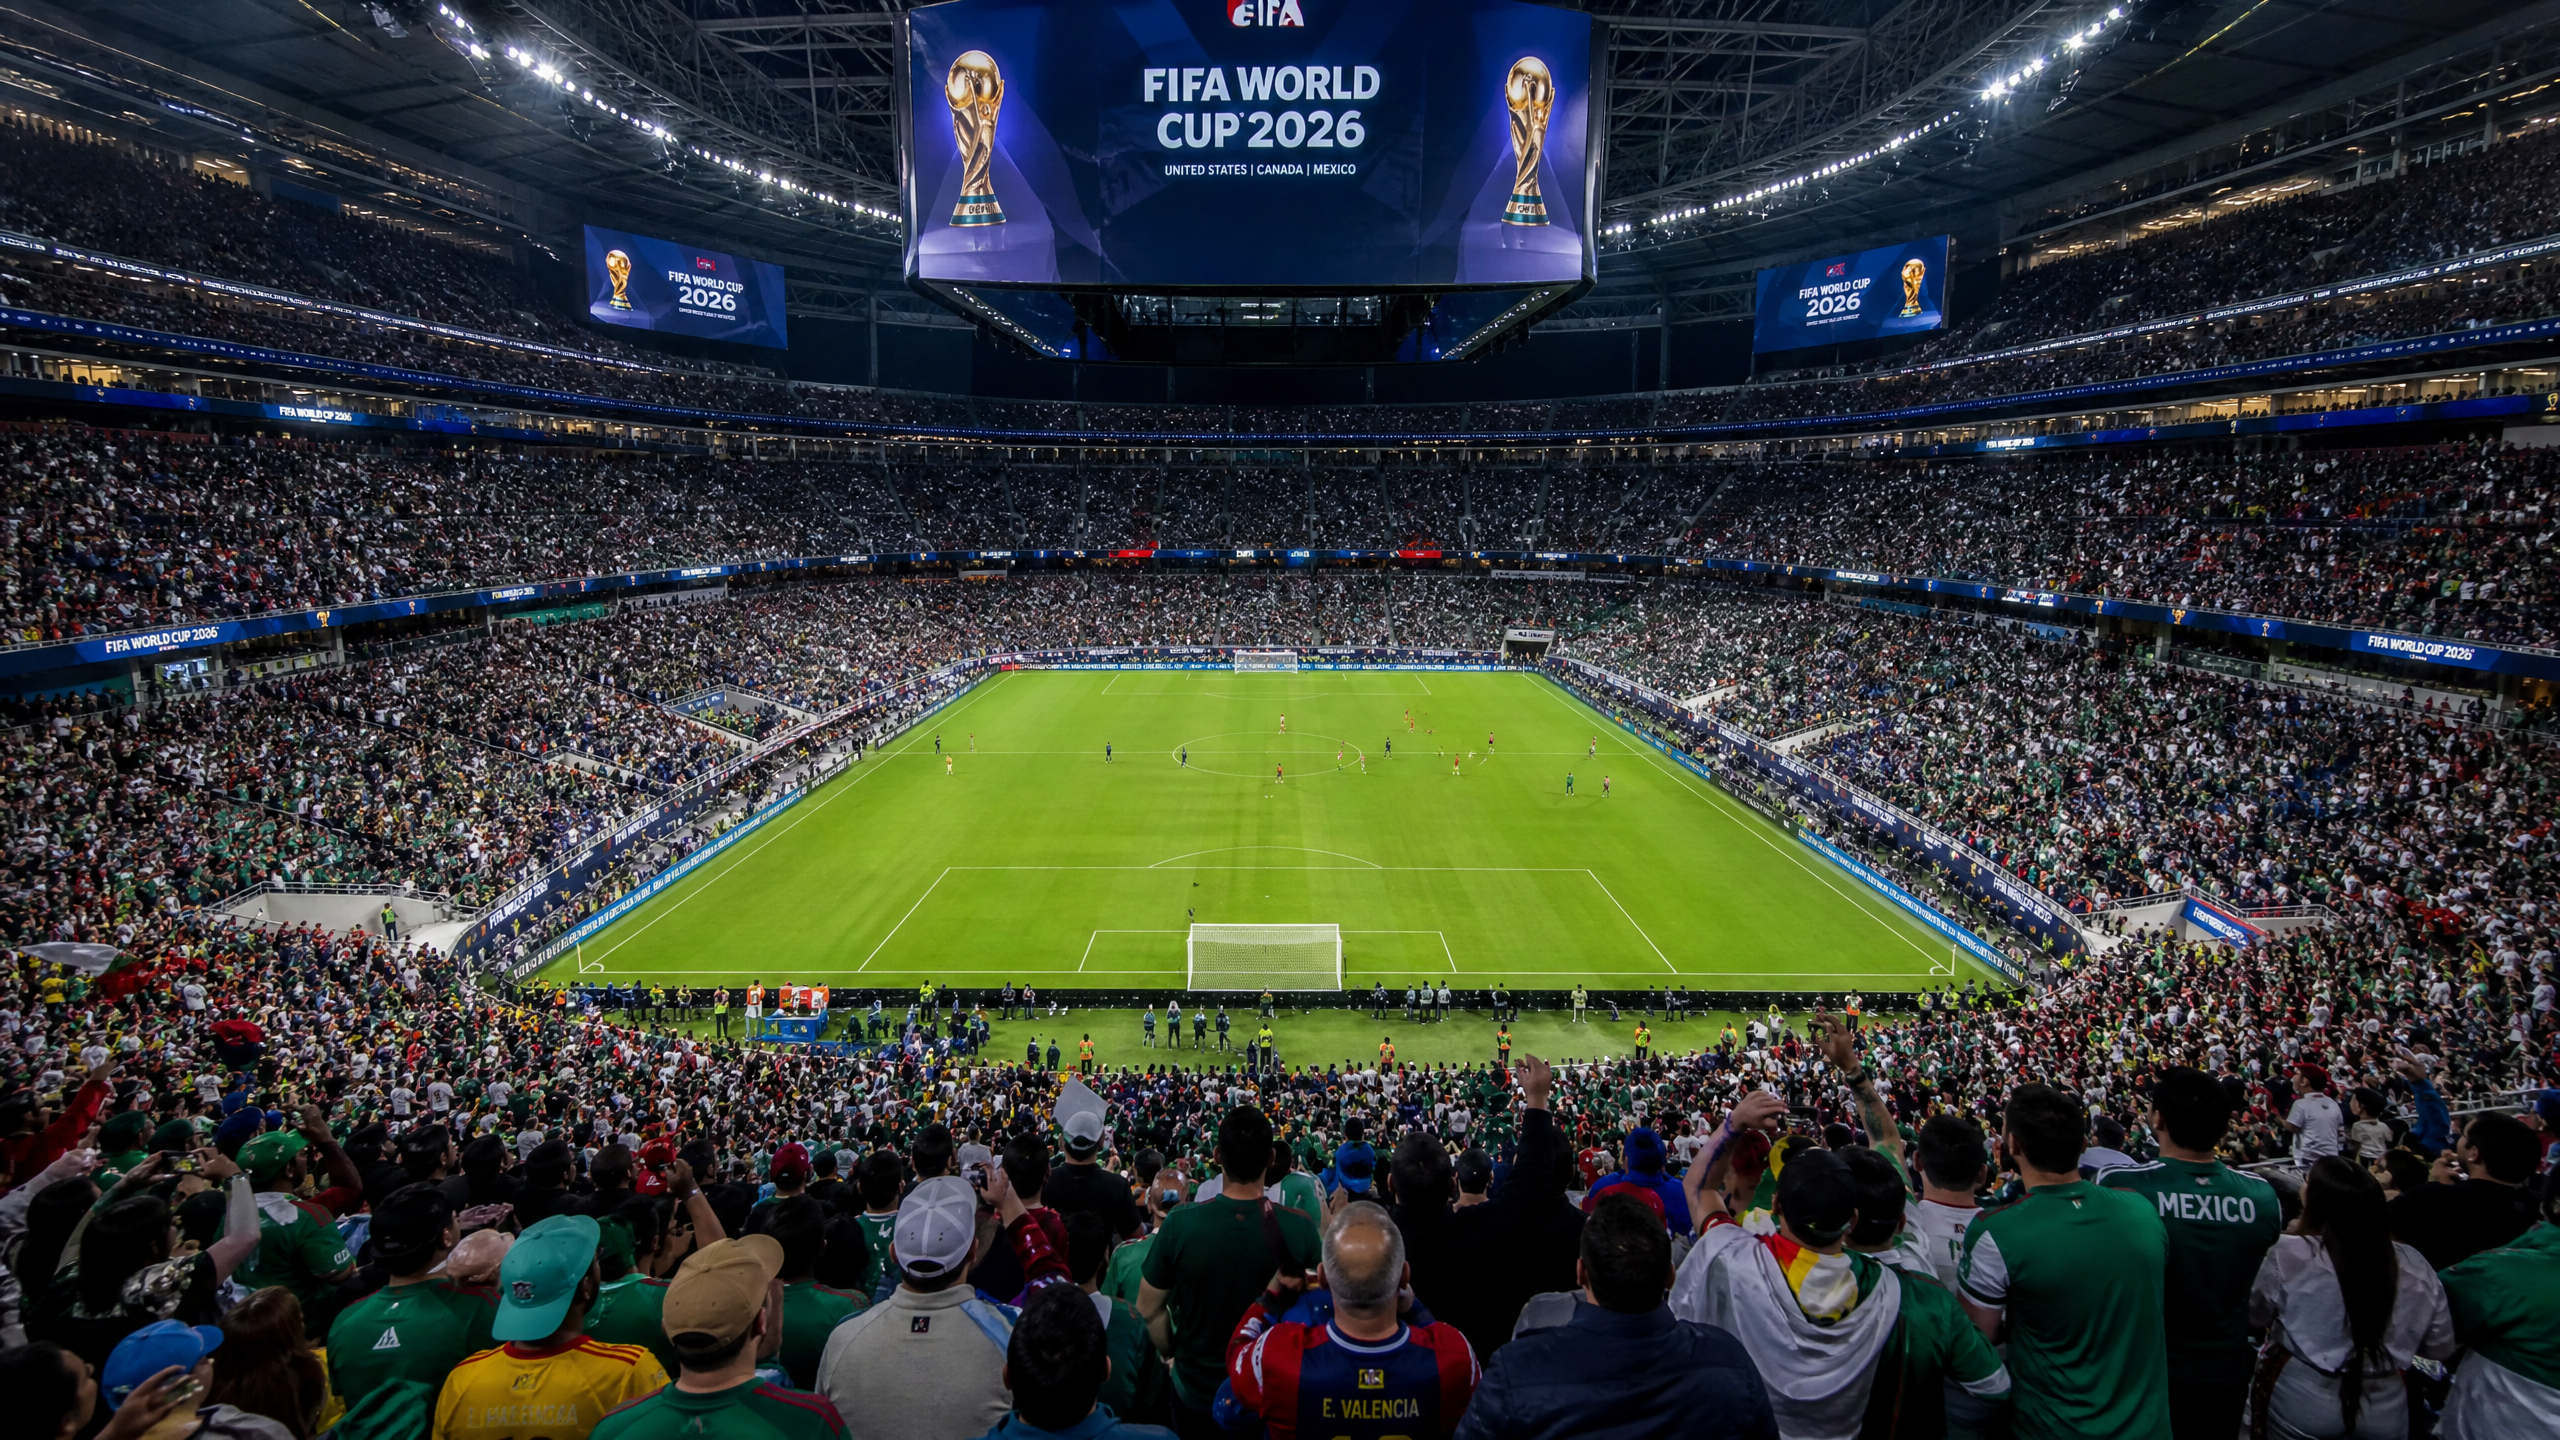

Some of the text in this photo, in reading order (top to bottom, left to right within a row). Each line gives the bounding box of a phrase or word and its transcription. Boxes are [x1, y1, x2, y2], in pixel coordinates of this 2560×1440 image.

[1144, 65, 1381, 102] FIFA WORLD
[1156, 109, 1366, 149] CUP 2026
[1164, 163, 1357, 176] UNITED STATES CANADA MEXICO
[668, 270, 744, 294] FIFA WORLD CUP
[1799, 277, 1871, 299] FIFA WORLD CUP
[679, 285, 737, 312] 2026
[1806, 292, 1861, 318] 2026
[105, 639, 131, 654] FIFA
[130, 633, 170, 650] WORLD
[171, 629, 191, 643] CUP
[2367, 635, 2389, 649] FIFA
[2390, 638, 2425, 654] WORLD
[2425, 643, 2444, 656] CUP
[2157, 1191, 2256, 1224] MEXICO
[1323, 1398, 1420, 1419] E. VALENCIA
